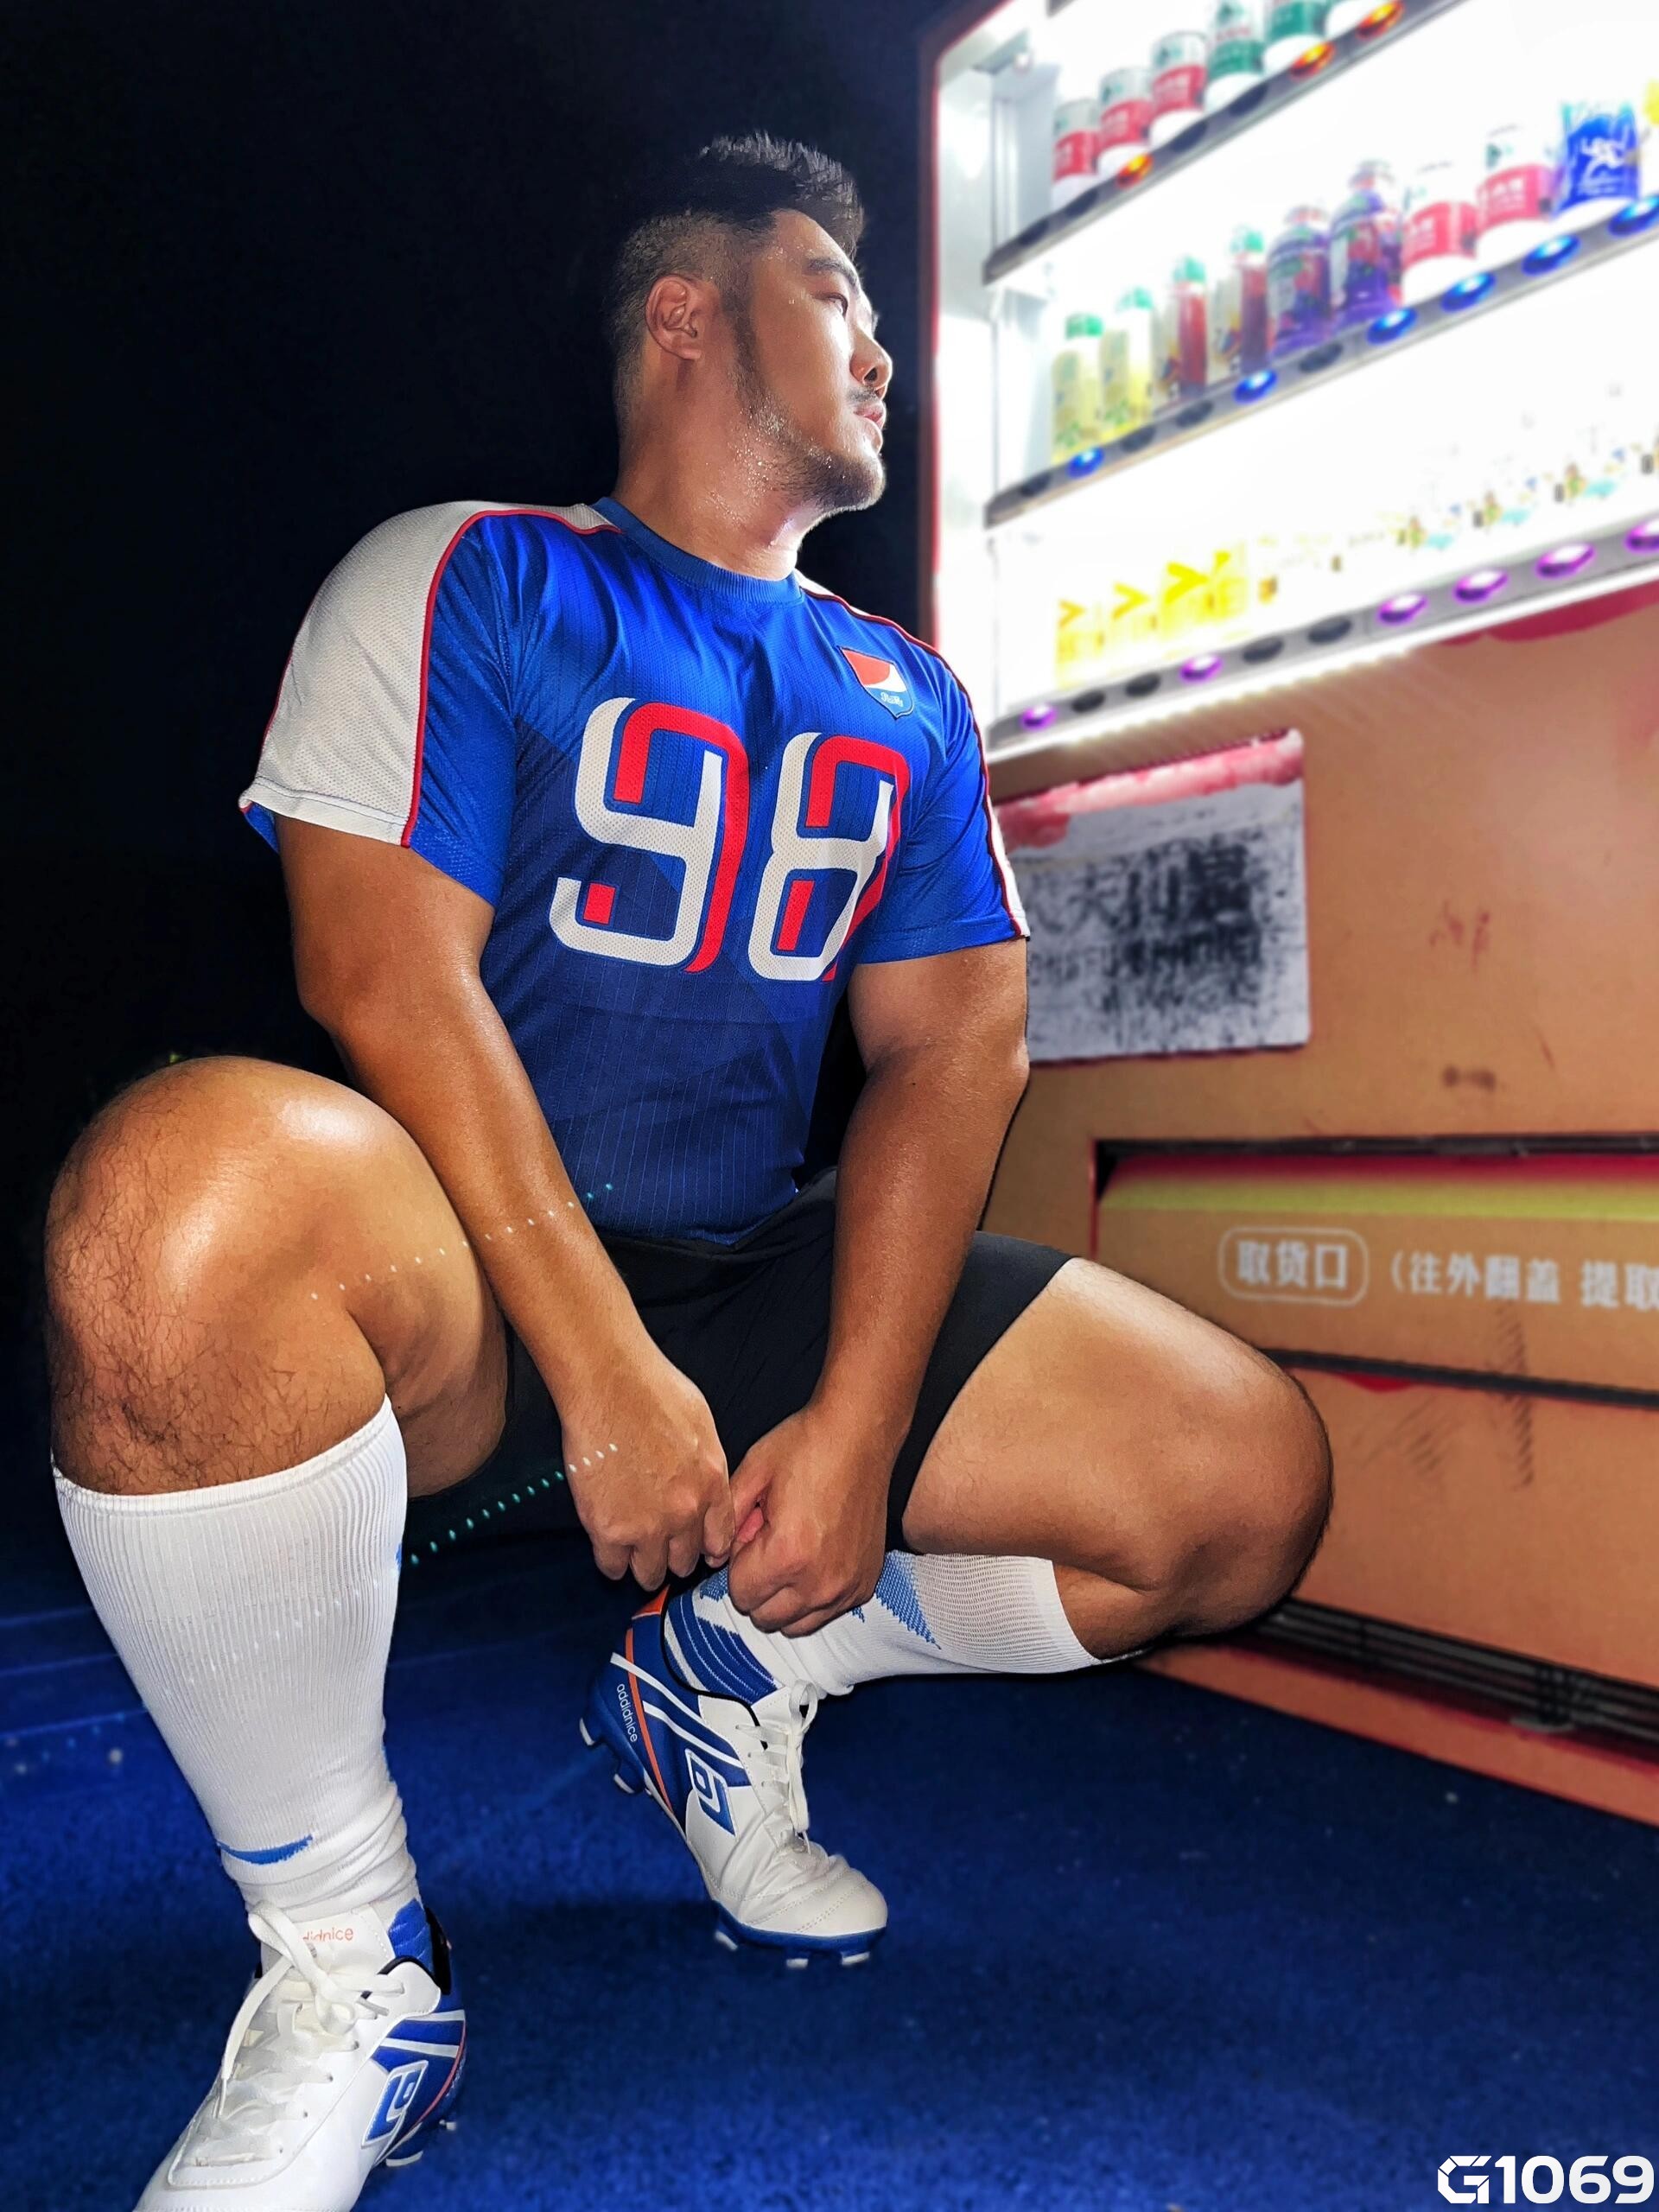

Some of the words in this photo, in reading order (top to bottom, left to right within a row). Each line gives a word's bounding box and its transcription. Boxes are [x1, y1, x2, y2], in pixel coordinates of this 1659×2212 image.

[549, 696, 910, 982] 98
[1237, 1240, 1348, 1289] 取货口
[616, 1683, 638, 1743] addidnice
